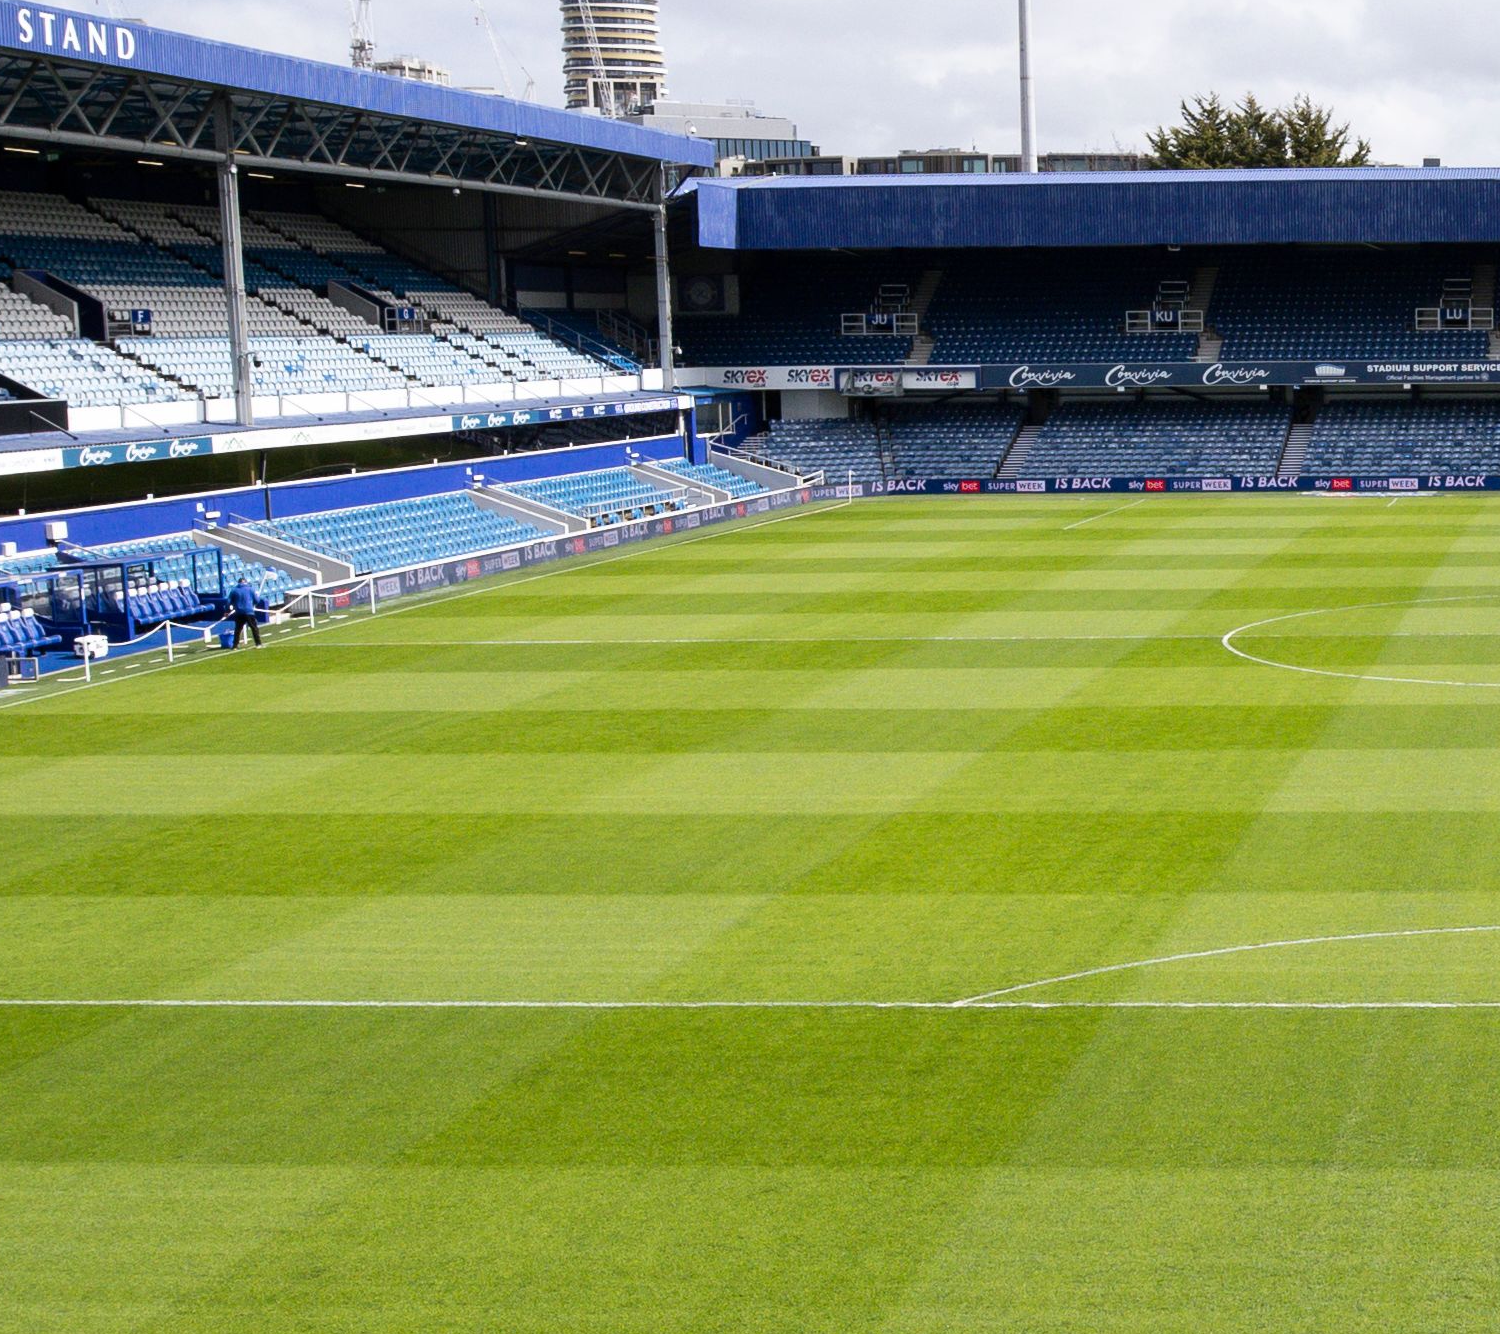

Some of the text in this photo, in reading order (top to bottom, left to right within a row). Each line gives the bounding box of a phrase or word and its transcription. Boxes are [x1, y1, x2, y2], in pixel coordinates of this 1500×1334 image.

[18, 8, 135, 60] STAND
[137, 310, 145, 323] F
[872, 313, 888, 325] JU
[1155, 311, 1173, 322] KU
[1446, 308, 1463, 320] LU
[1105, 364, 1173, 386] Convivia
[1202, 363, 1270, 385] Convivia
[1367, 364, 1411, 373] STADIUM
[1413, 363, 1458, 372] SUPPORT
[1009, 365, 1076, 387] Convivia
[871, 479, 926, 492] IS BACK
[943, 478, 1111, 492] sky bet SUPER WEEK IS BACK
[1128, 477, 1298, 491] sky bet SUPER WEEK IS BACK
[1314, 476, 1485, 490] sky bet SUPER WEEK IS BACK
